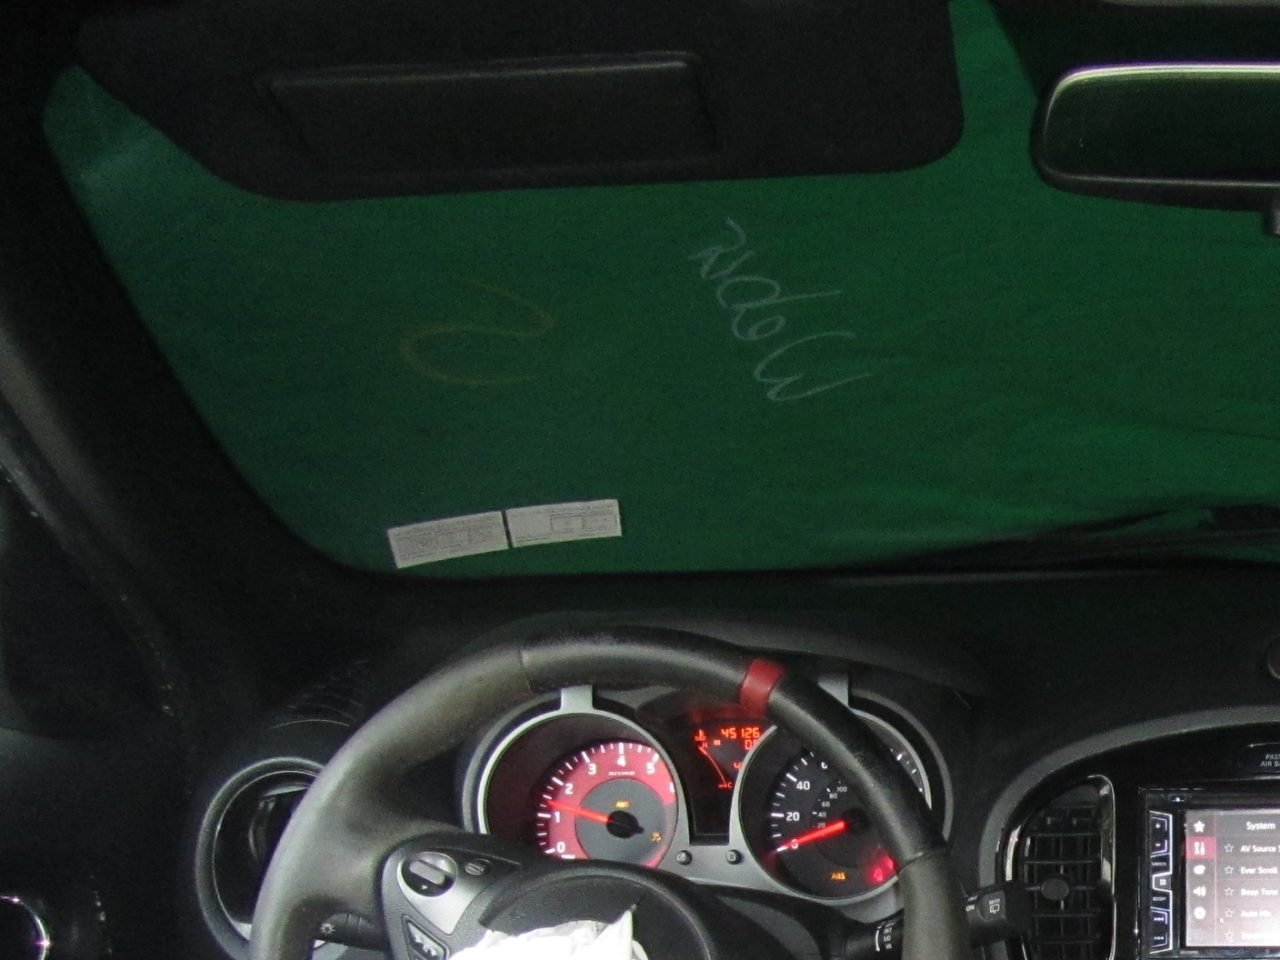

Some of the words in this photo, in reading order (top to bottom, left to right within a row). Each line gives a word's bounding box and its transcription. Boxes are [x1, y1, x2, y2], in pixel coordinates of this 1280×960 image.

[721, 727, 760, 739] 45126
[588, 763, 597, 775] 3
[646, 762, 656, 775] 5
[565, 783, 574, 795] 2
[796, 780, 811, 791] 40
[554, 811, 561, 823] 1
[786, 811, 800, 821] 20
[1246, 821, 1276, 832] System
[556, 842, 566, 853] 0
[1240, 844, 1251, 853] AV
[1252, 844, 1277, 853] Source
[1240, 866, 1255, 874] Ever
[1257, 866, 1278, 874] Scroll
[831, 872, 846, 880] ABS
